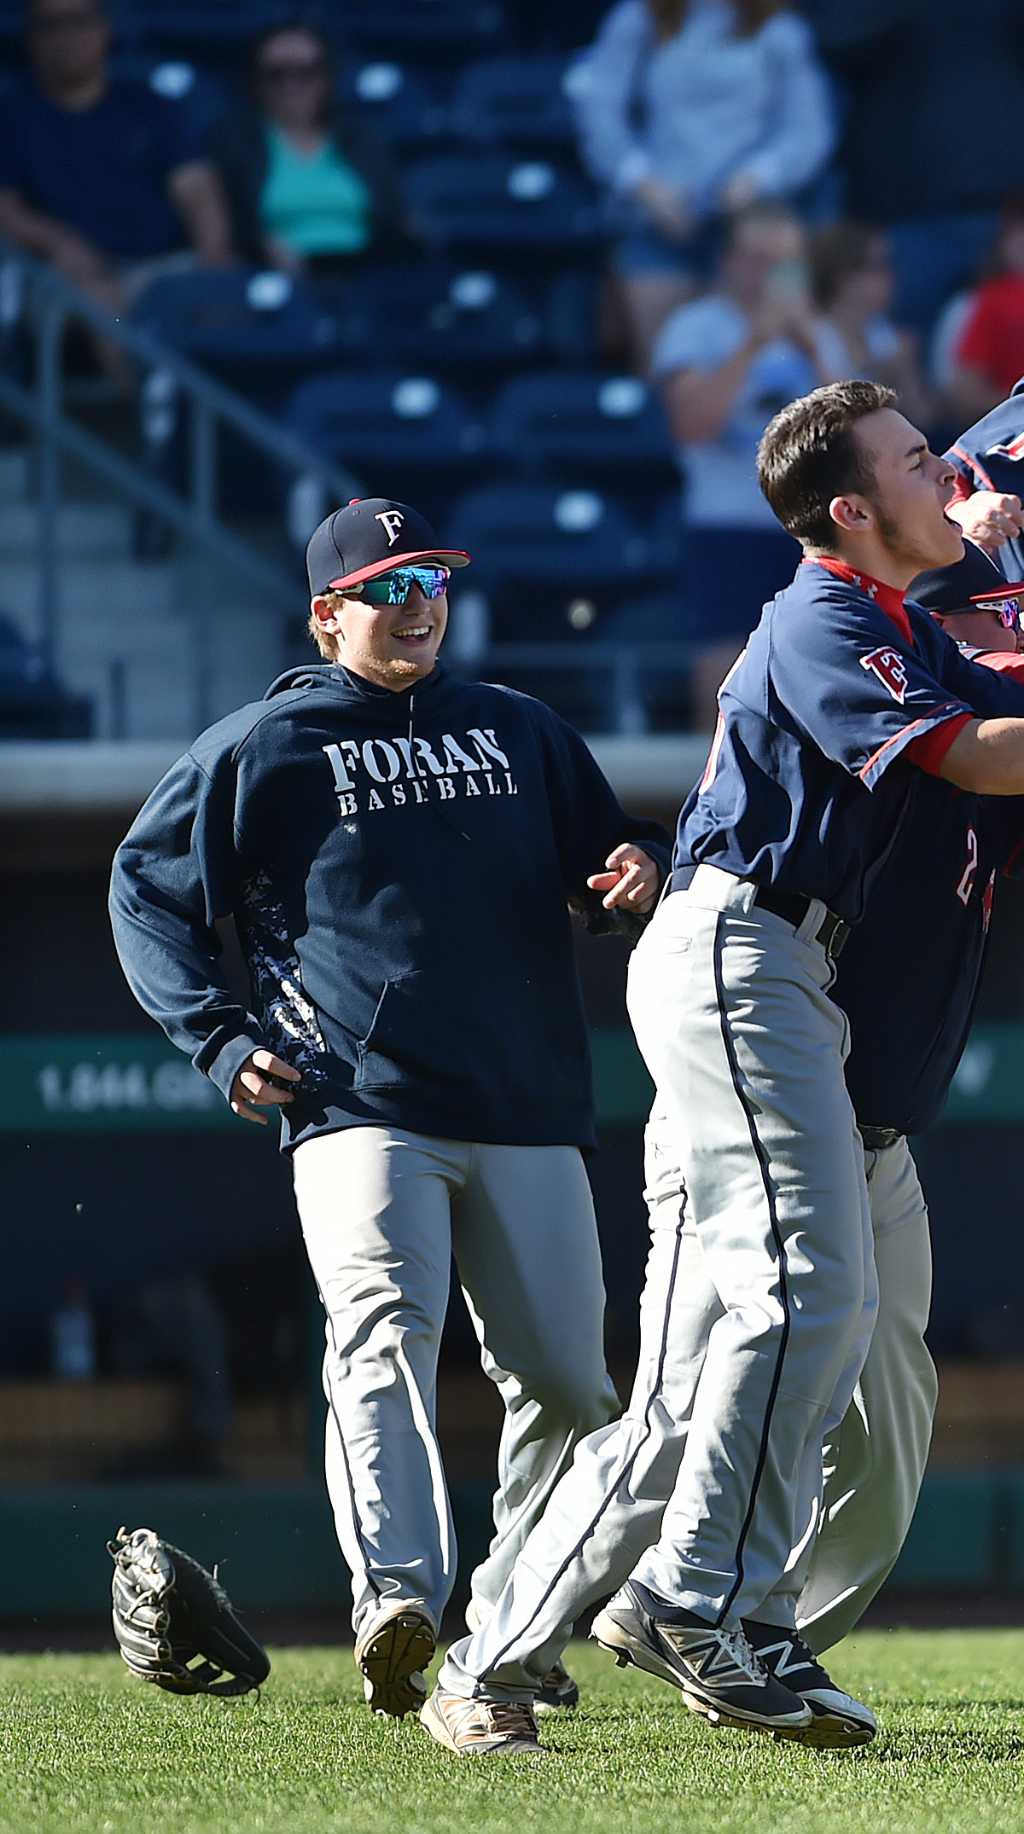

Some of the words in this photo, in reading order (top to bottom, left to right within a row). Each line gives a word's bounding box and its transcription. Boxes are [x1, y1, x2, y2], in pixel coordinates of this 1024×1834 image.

[374, 510, 404, 547] F
[322, 728, 510, 793] FORAN
[337, 772, 518, 817] BASEBALL
